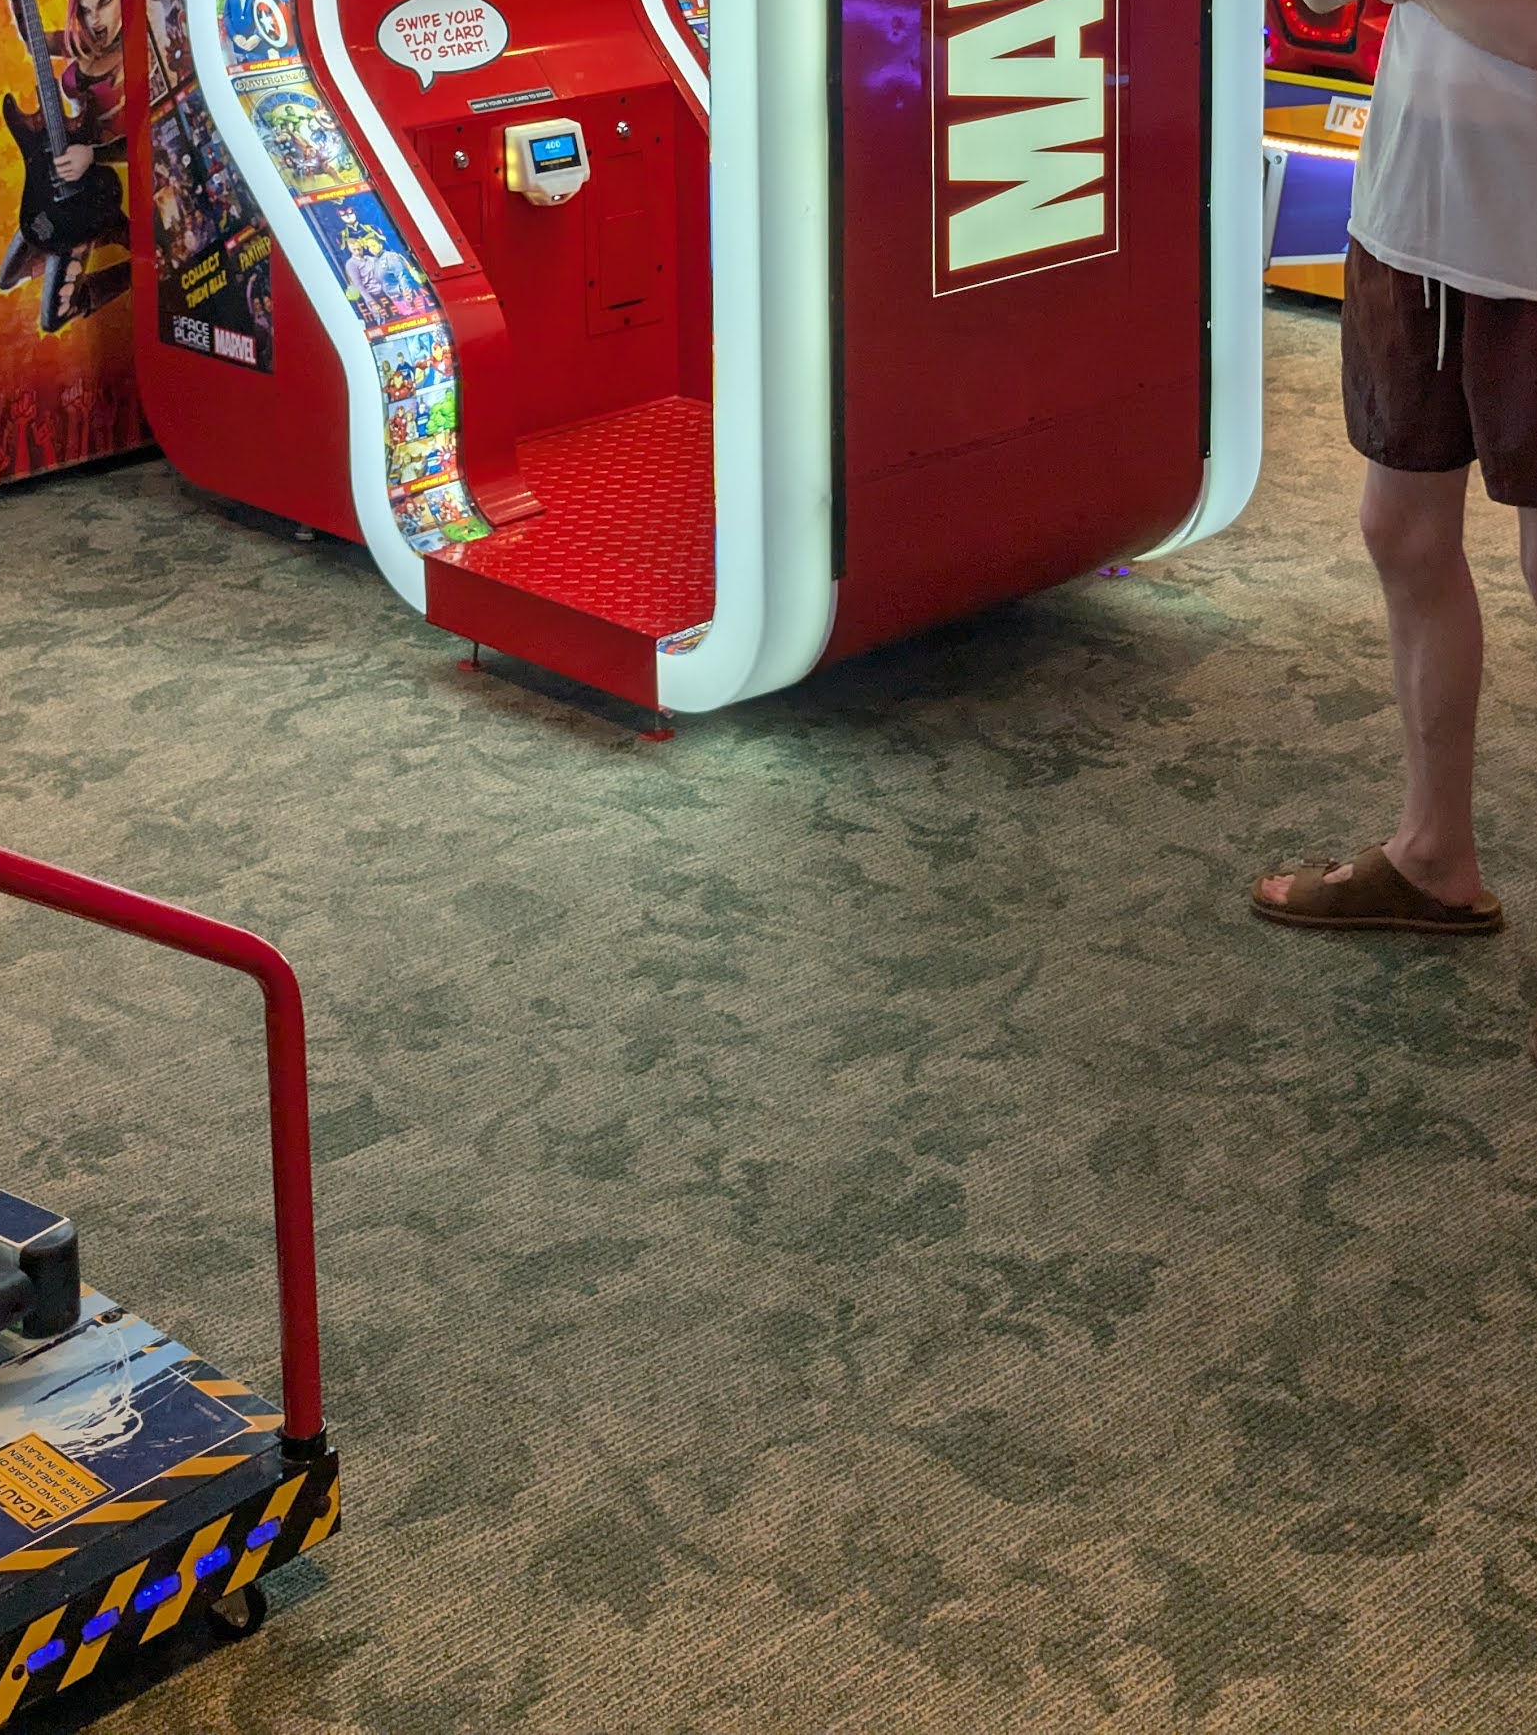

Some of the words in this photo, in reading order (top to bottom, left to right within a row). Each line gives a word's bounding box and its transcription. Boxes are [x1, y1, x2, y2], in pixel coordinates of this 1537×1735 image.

[395, 12, 442, 33] SWIPE
[445, 7, 485, 26] YOUR
[403, 29, 438, 47] PLAY
[443, 24, 484, 42] CARD
[410, 46, 432, 62] TO
[437, 40, 490, 59] START!
[1331, 102, 1368, 130] IT'S
[545, 140, 561, 150] 400
[181, 251, 220, 289] COLLECT
[186, 283, 209, 309] THEM
[209, 270, 227, 295] ALL!
[181, 316, 210, 335] FACE
[174, 327, 210, 347] PLACE
[214, 326, 257, 364] MARVEL
[7, 1449, 35, 1470] WHEN
[19, 1442, 48, 1462] PLAY!
[45, 1460, 57, 1470] IN
[56, 1469, 68, 1477] IS
[7, 1466, 39, 1488] CLEAR
[35, 1469, 63, 1487] AREA
[66, 1476, 95, 1496] GAME
[37, 1488, 70, 1511] STAND
[59, 1487, 82, 1504] THIS
